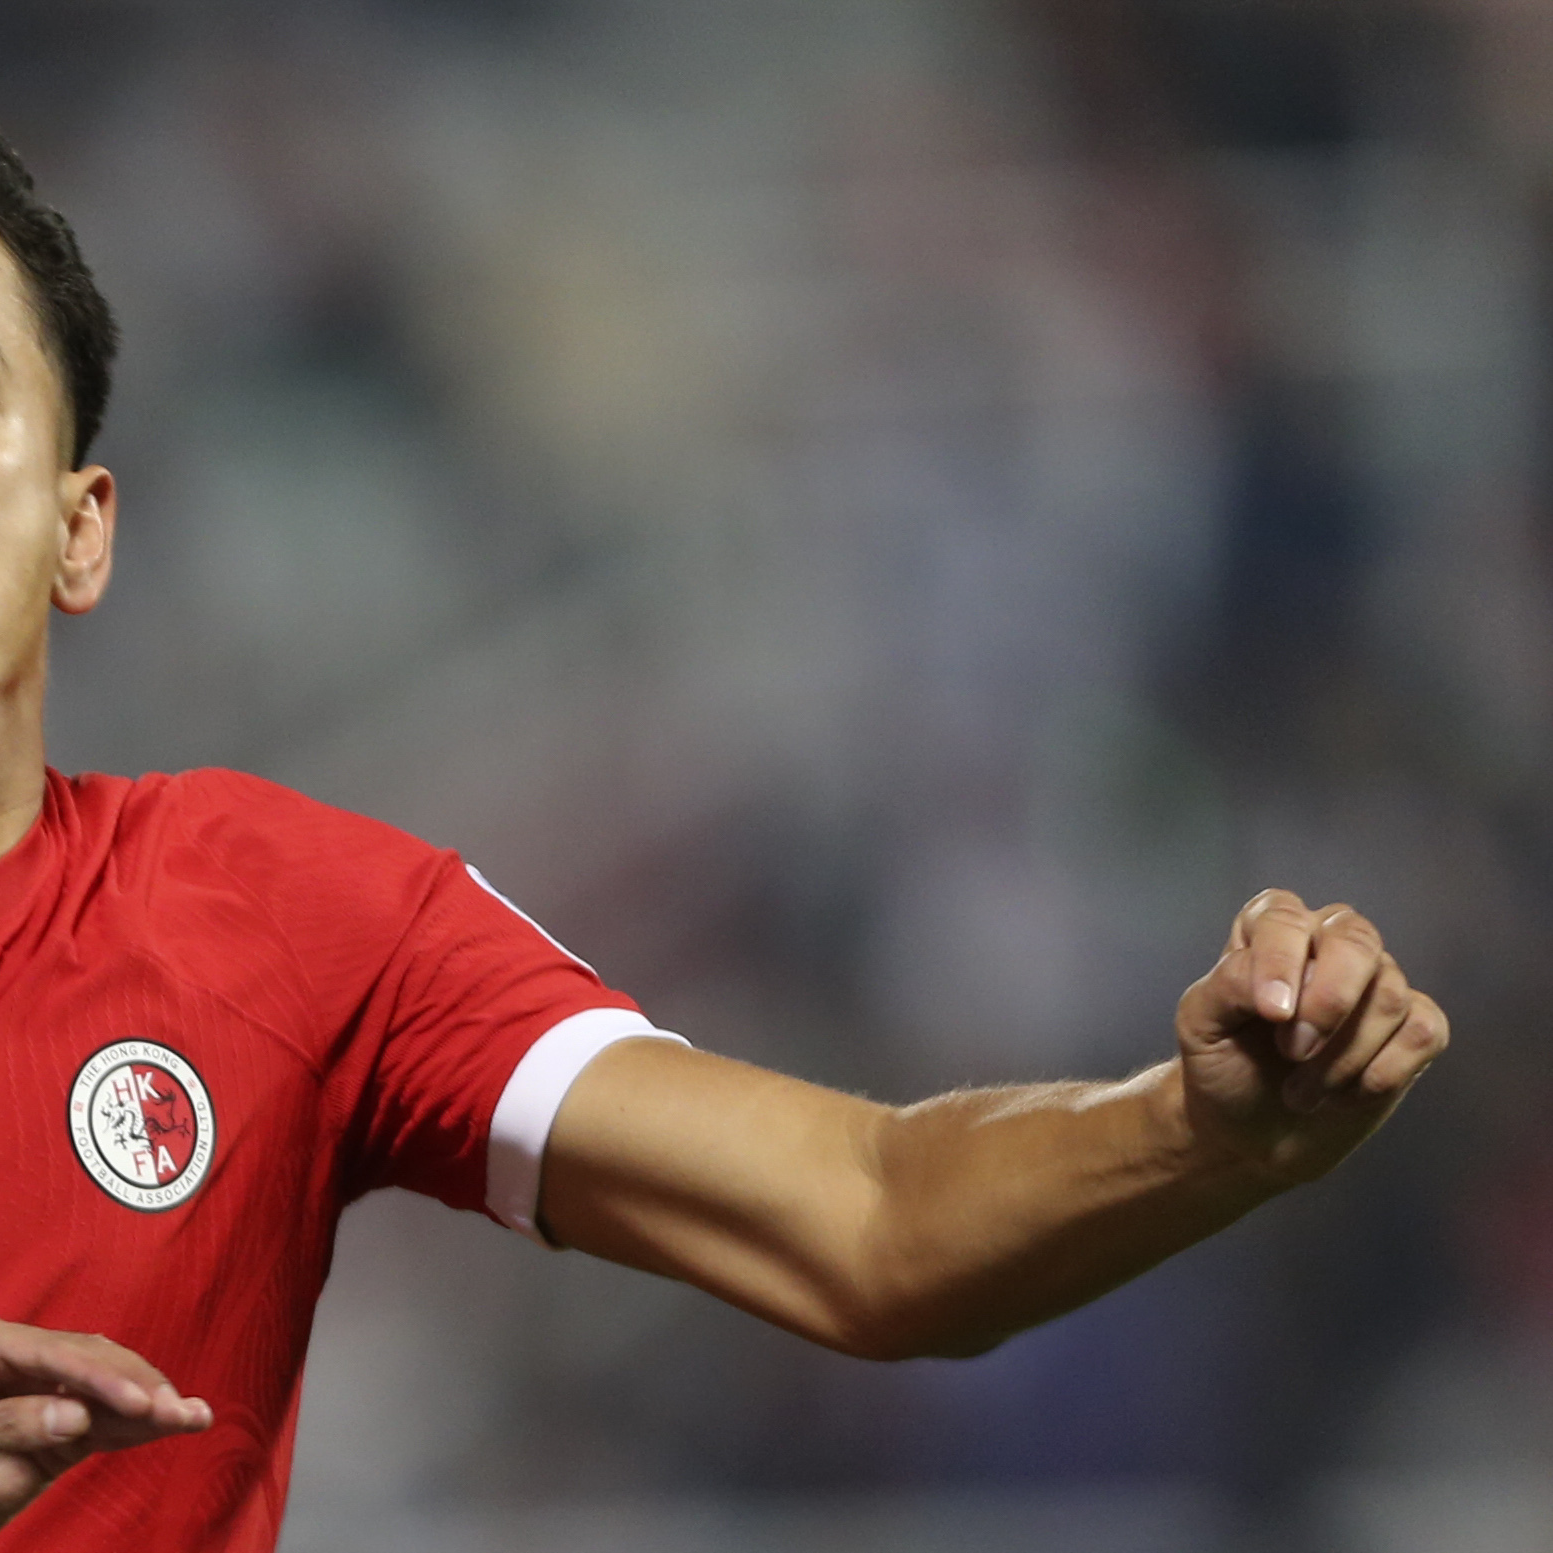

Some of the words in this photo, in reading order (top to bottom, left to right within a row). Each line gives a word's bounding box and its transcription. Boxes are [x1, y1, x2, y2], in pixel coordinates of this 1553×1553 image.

[79, 1062, 101, 1088] THE
[100, 1044, 138, 1065] HONG
[143, 1046, 179, 1070] KONG
[75, 1126, 130, 1200] FOOTBALL
[136, 1140, 209, 1204] ASSOCIATION
